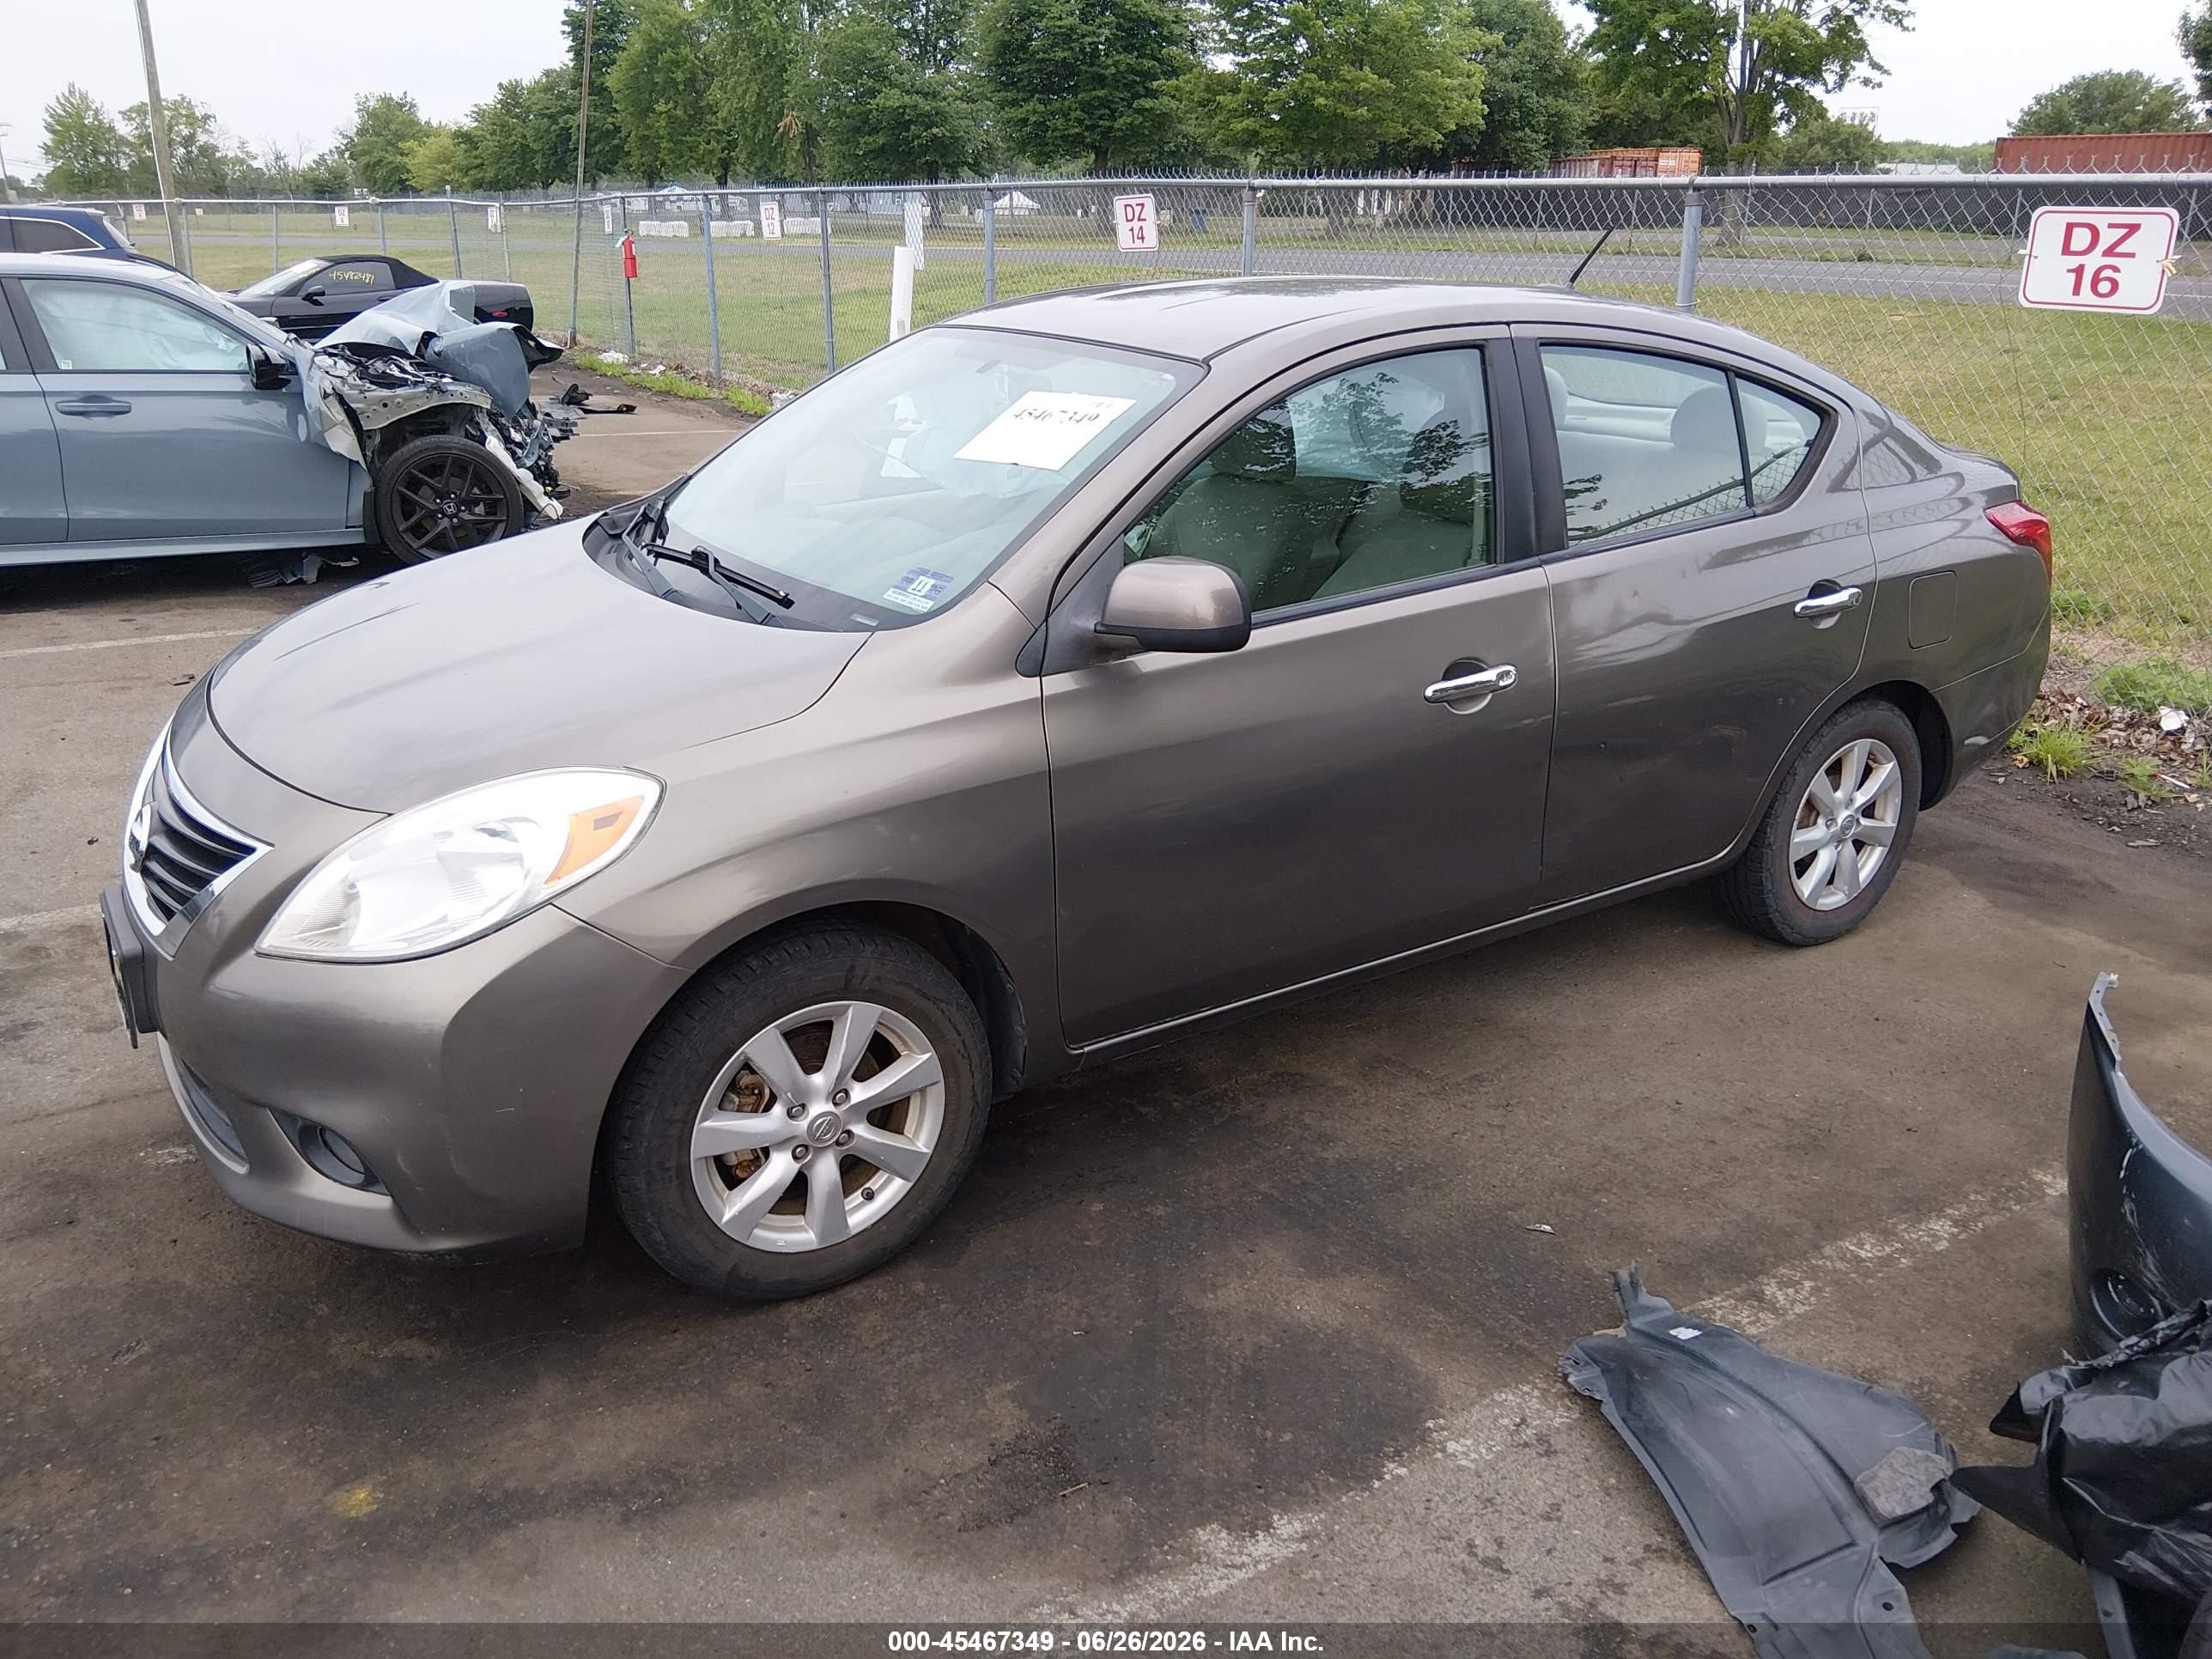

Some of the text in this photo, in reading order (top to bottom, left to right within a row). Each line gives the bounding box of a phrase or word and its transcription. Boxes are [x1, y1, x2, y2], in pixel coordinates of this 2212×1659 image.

[764, 207, 775, 221] DZ
[1123, 203, 1147, 222] DZ
[768, 222, 775, 235] 12
[1128, 225, 1146, 245] 14
[2061, 222, 2142, 258] DZ
[2066, 263, 2122, 299] 16
